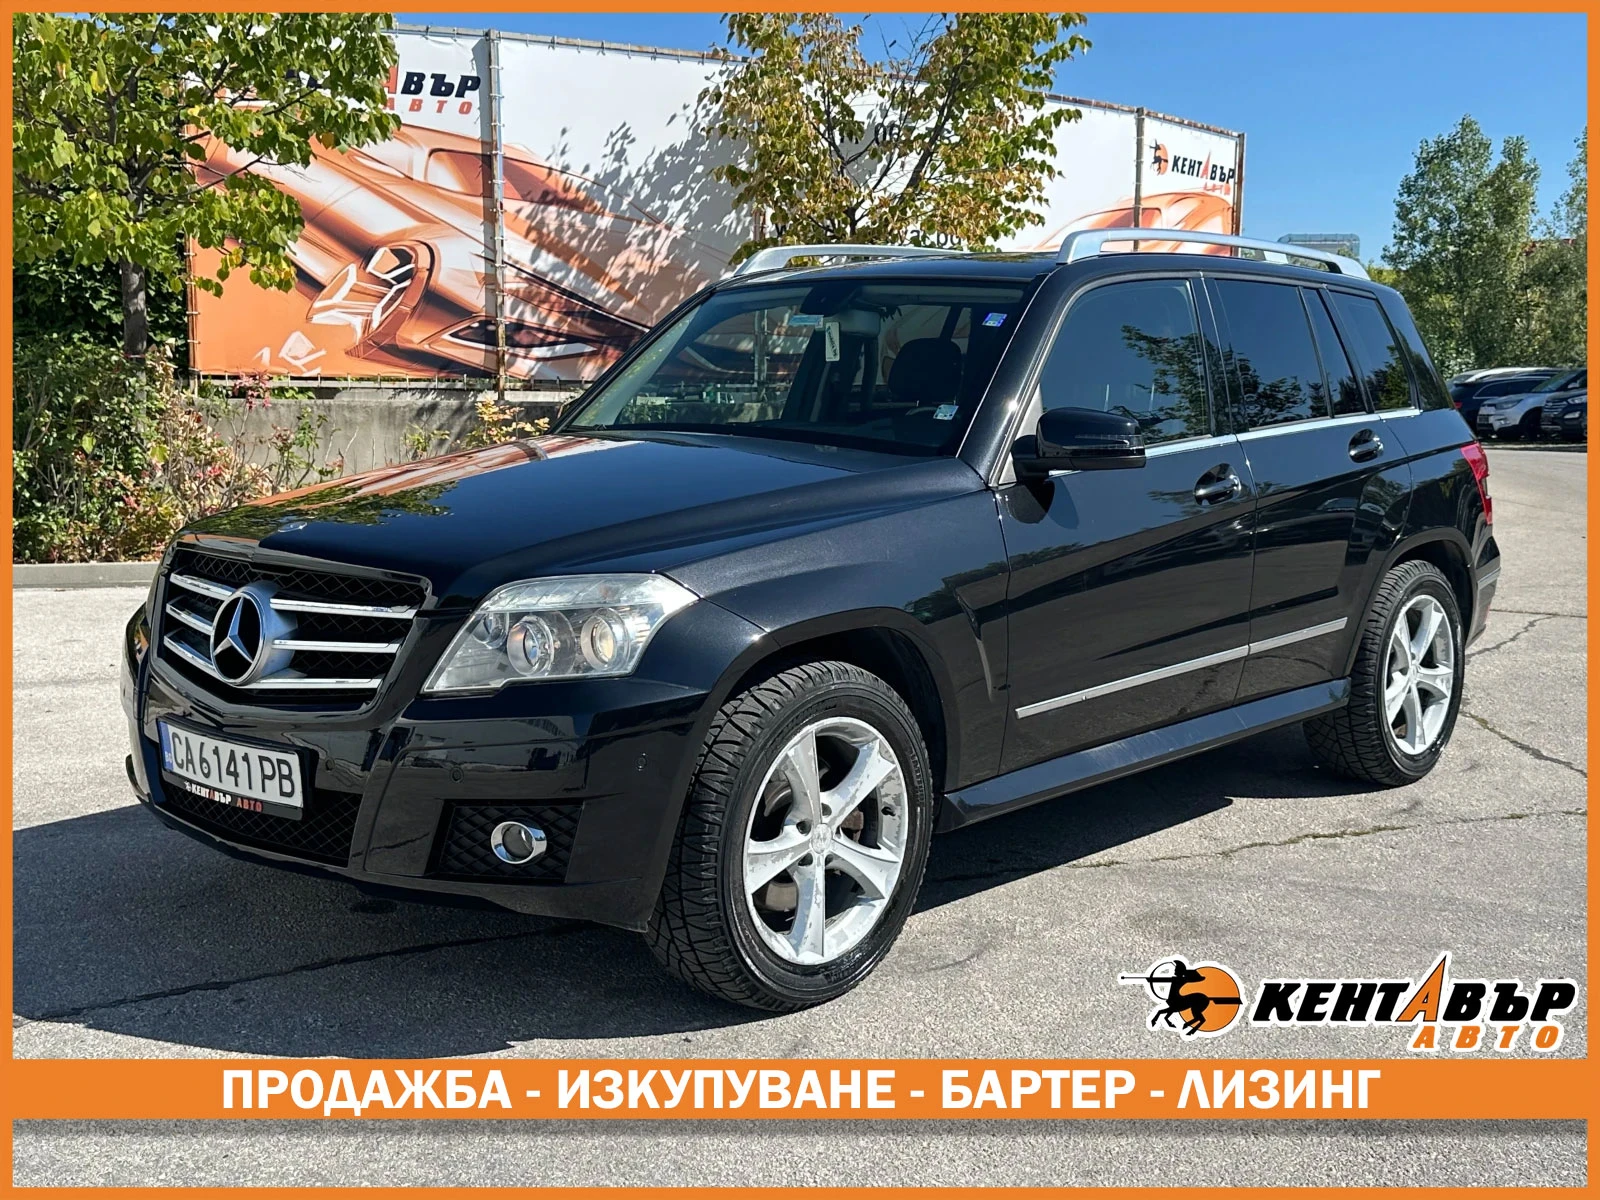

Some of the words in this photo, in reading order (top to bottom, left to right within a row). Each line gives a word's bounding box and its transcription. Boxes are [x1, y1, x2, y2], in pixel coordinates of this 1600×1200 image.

[1171, 149, 1235, 184] КЕНТАВЪР
[191, 783, 232, 804] КЕНТАВЪР
[236, 797, 264, 813] АВТО
